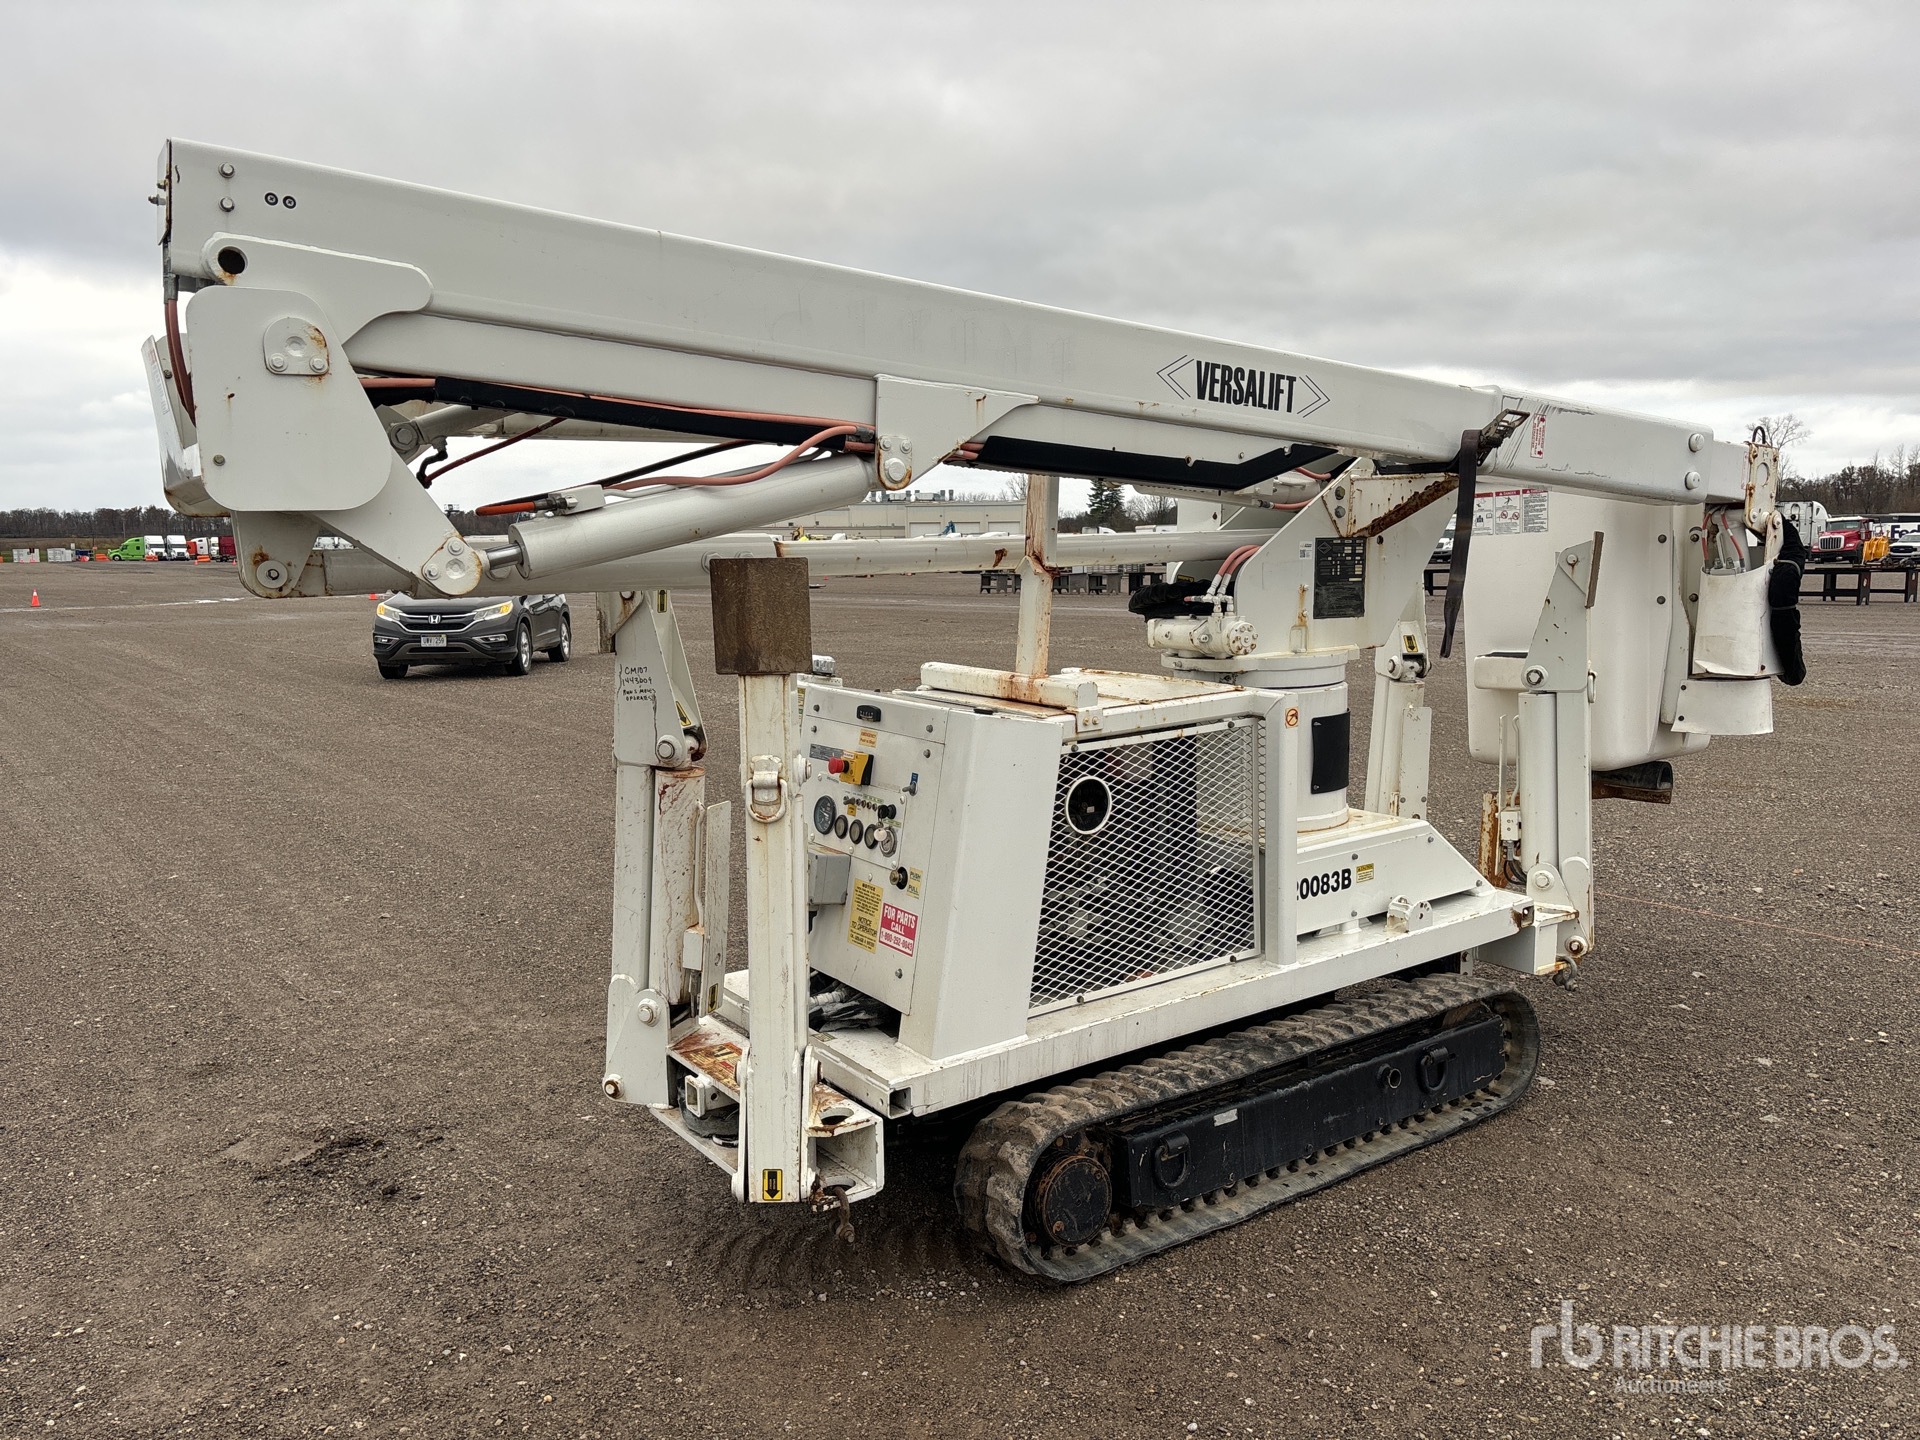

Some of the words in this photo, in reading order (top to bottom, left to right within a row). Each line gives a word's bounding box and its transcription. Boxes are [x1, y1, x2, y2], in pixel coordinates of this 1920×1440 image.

[1196, 360, 1297, 413] VERSALIFT
[908, 884, 919, 893] PULL
[1297, 868, 1352, 900] 0083B
[884, 905, 896, 921] FOR
[896, 910, 916, 928] PARTS
[890, 922, 905, 935] CALL
